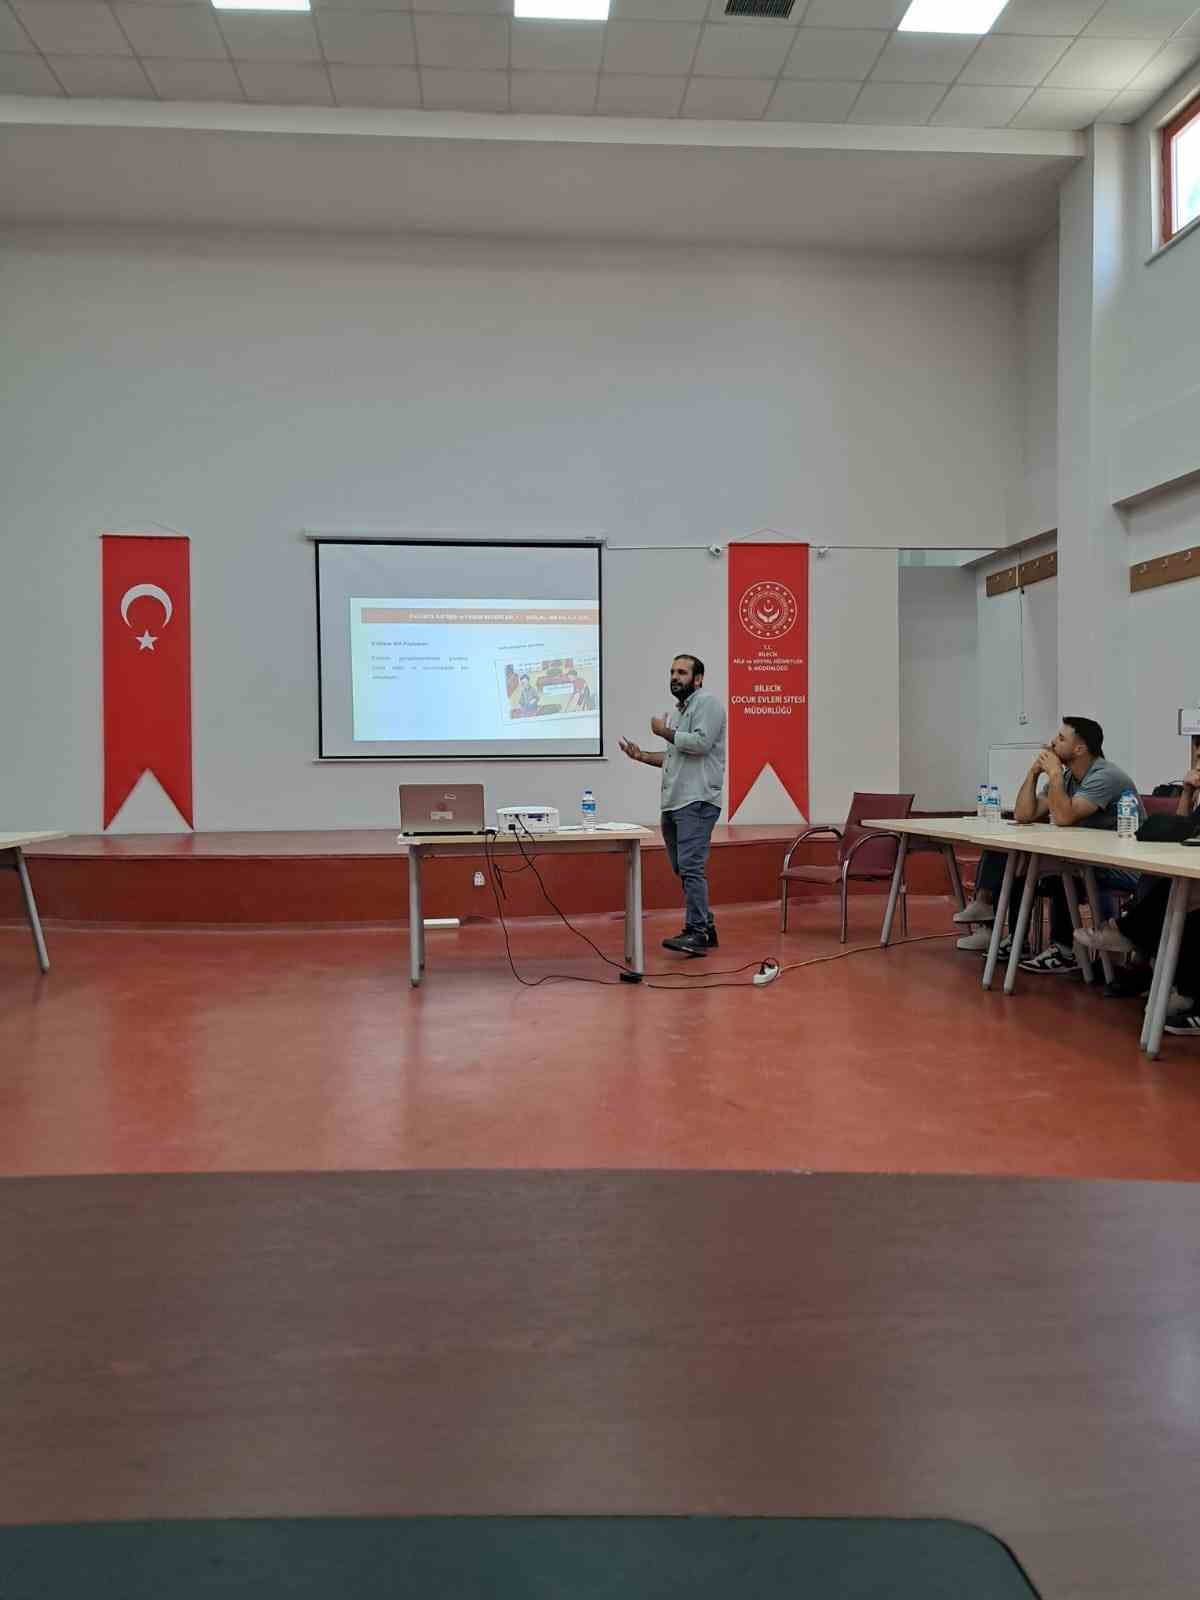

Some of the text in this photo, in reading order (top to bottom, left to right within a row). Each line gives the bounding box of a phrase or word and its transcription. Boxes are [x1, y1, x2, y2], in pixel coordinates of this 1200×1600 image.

[754, 684, 781, 692] BİLECİK
[731, 695, 806, 704] ÇOCUK EVLERİ SİTESİ
[744, 705, 792, 714] MÜDÜRLÜĞÜ
